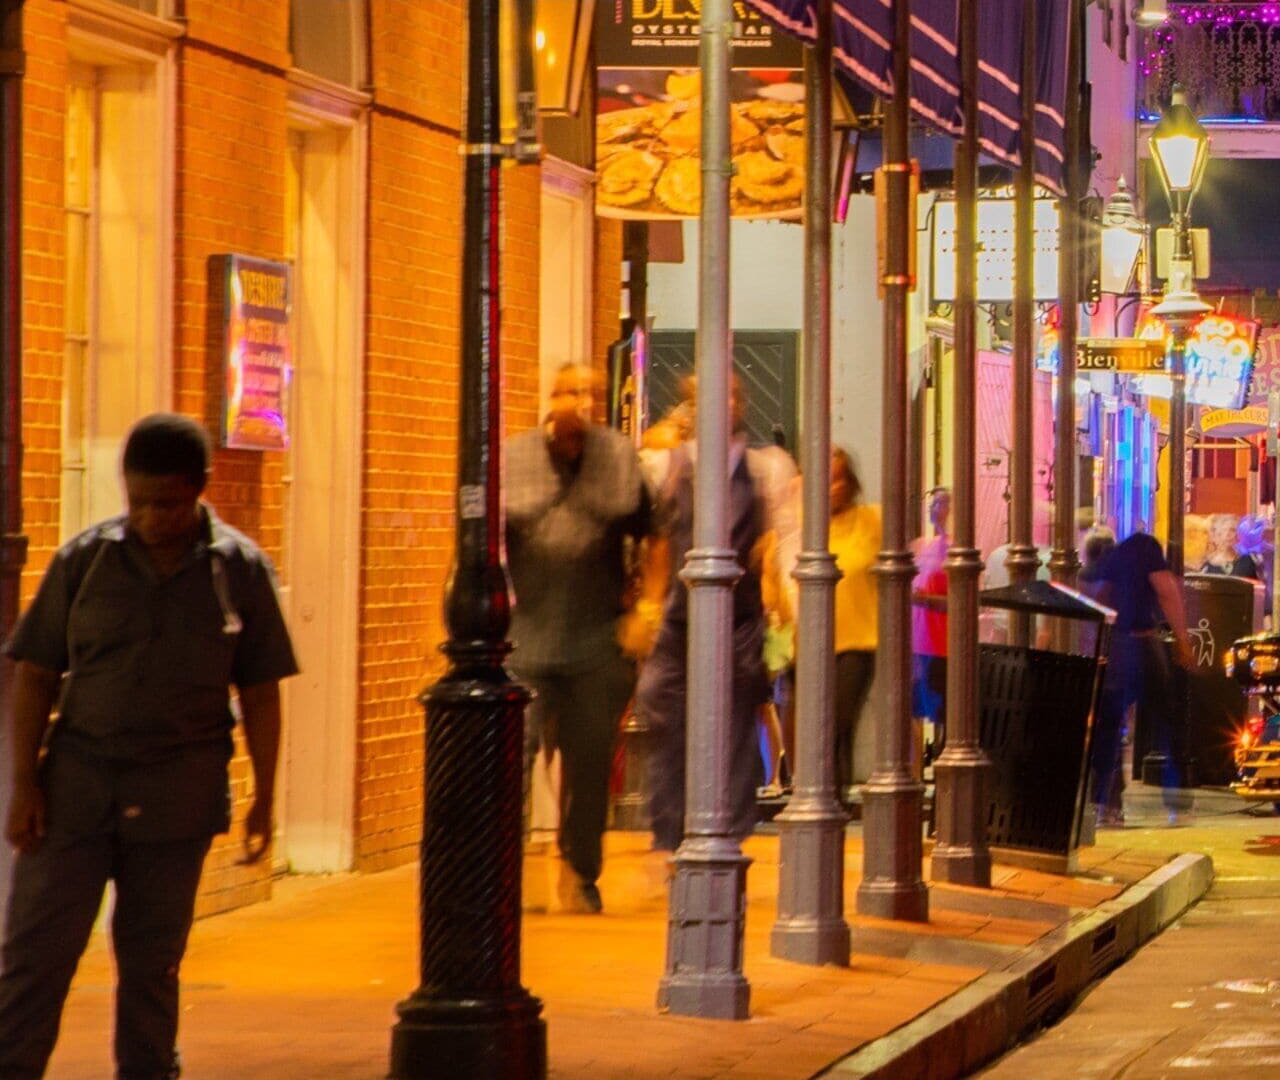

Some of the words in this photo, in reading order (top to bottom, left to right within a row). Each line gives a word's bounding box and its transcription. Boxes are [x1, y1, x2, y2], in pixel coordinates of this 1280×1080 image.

[631, 25, 701, 35] OYSTE
[745, 25, 772, 35] AR
[1075, 347, 1165, 368] Bienville
